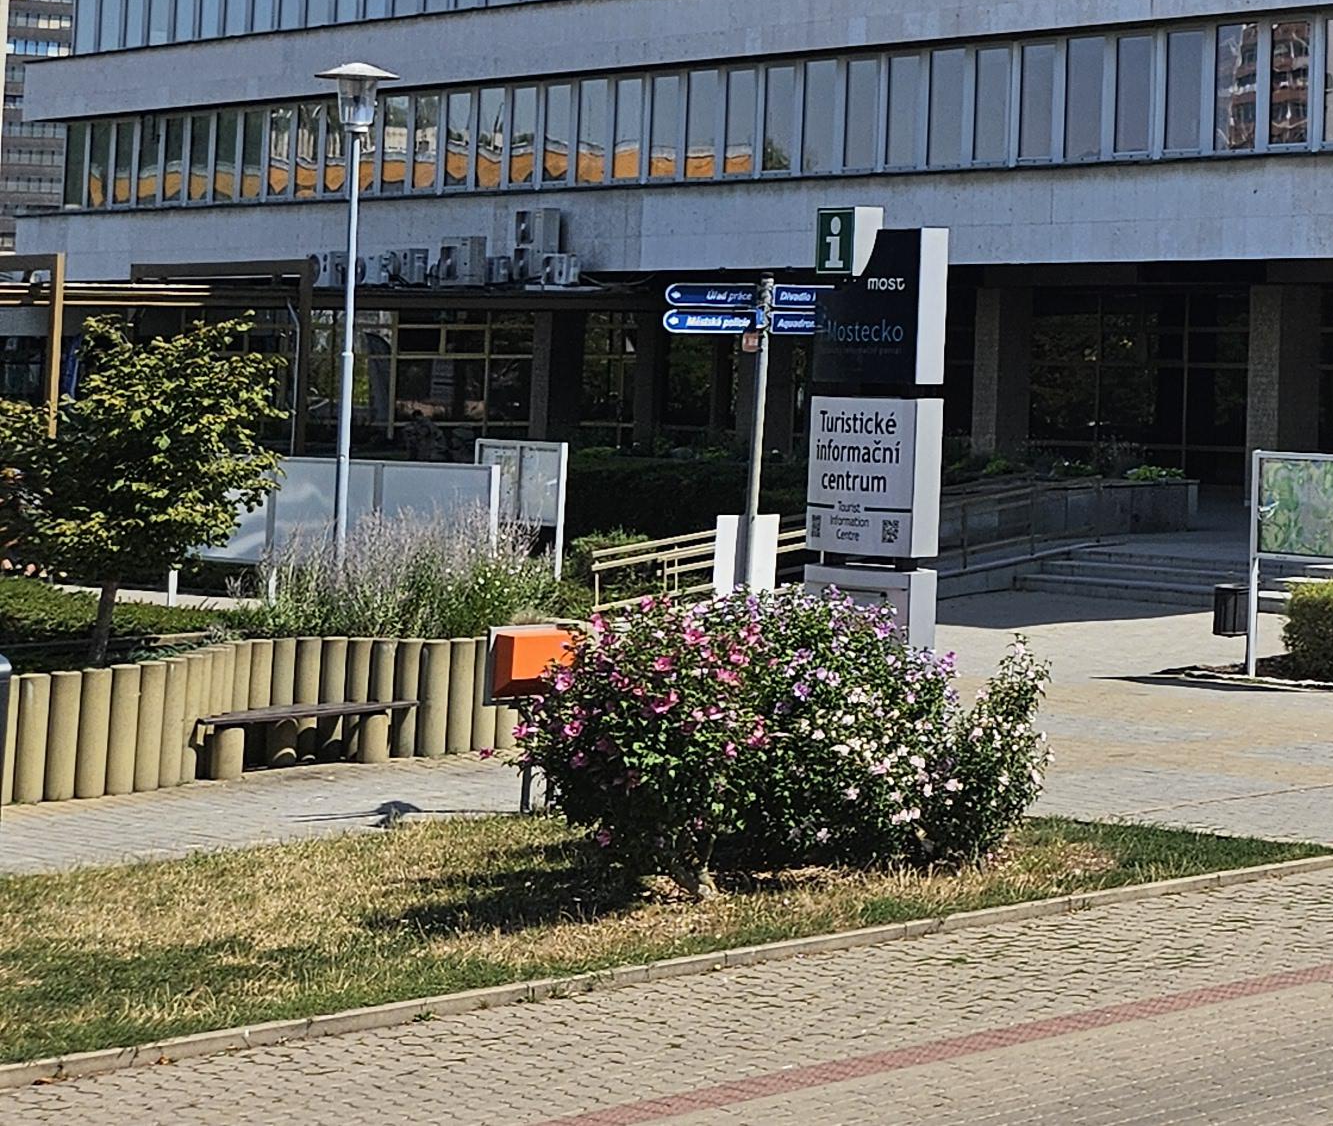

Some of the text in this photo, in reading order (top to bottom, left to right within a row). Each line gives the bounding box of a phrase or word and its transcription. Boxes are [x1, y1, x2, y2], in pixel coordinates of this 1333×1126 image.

[867, 277, 905, 291] most
[820, 410, 897, 435] Turistické
[816, 439, 901, 464] informační
[821, 471, 887, 493] centrum
[838, 501, 861, 513] Tourist
[830, 515, 870, 528] Information
[836, 528, 860, 541] Centre
